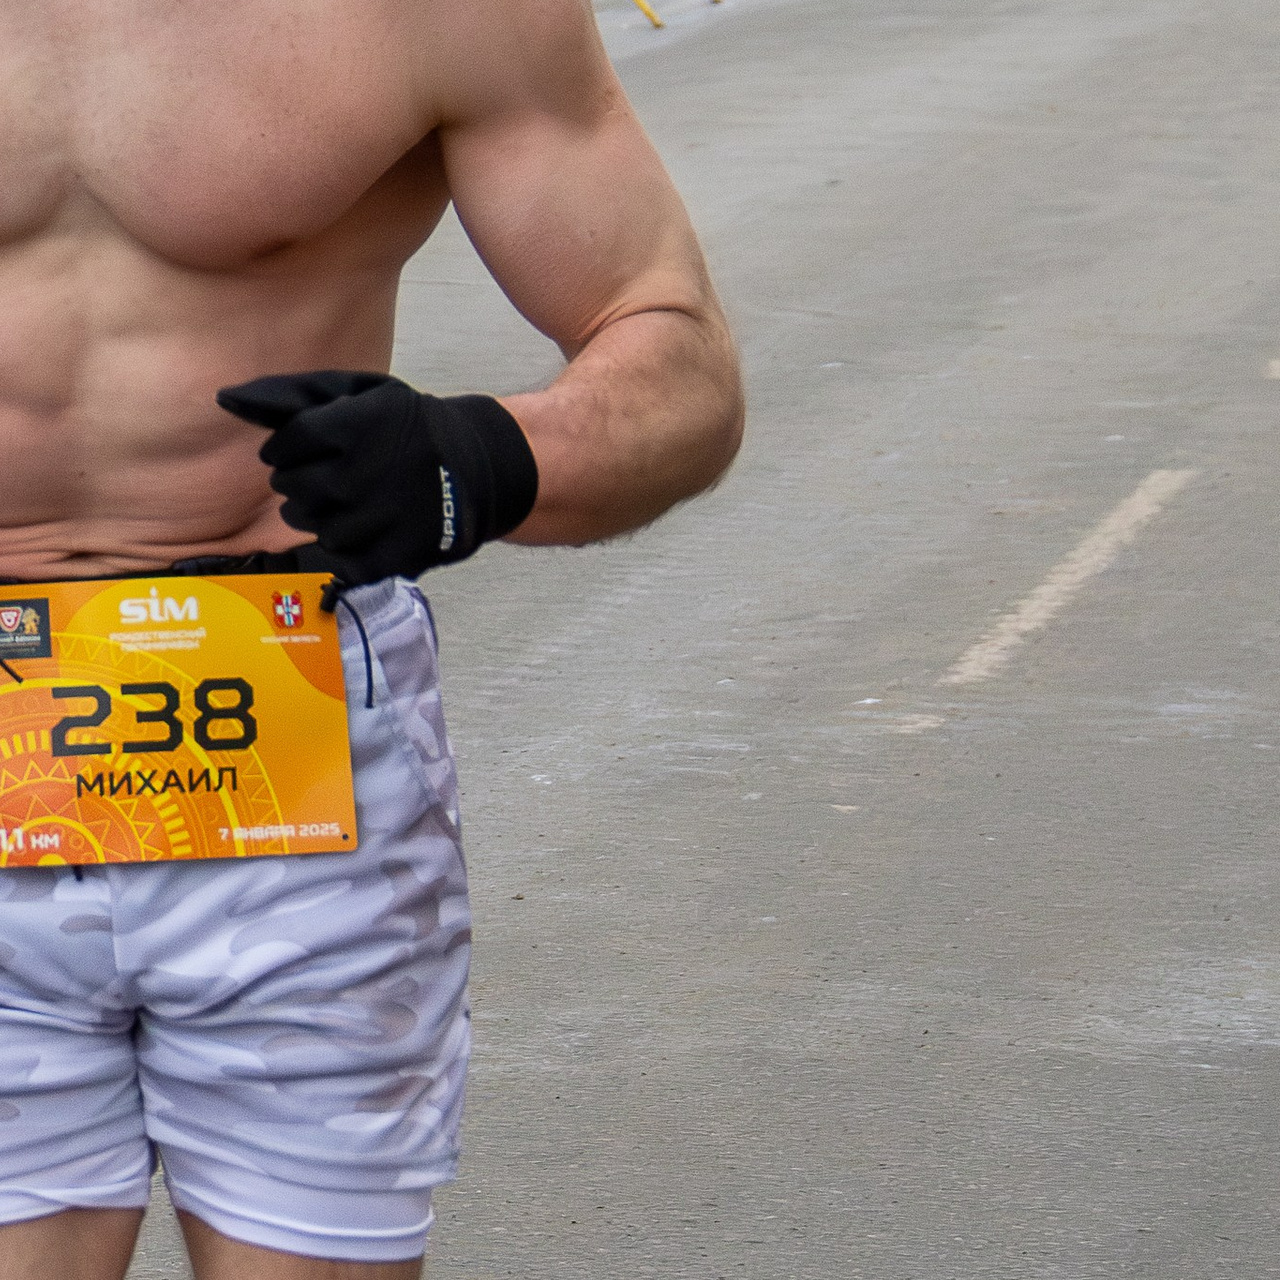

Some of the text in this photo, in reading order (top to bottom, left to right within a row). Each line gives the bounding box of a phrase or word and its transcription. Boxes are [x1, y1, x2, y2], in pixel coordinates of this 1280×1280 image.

[51, 677, 258, 758] 238
[76, 767, 238, 799] МИХАИЛ
[218, 828, 229, 841] 7
[299, 822, 341, 837] 2025
